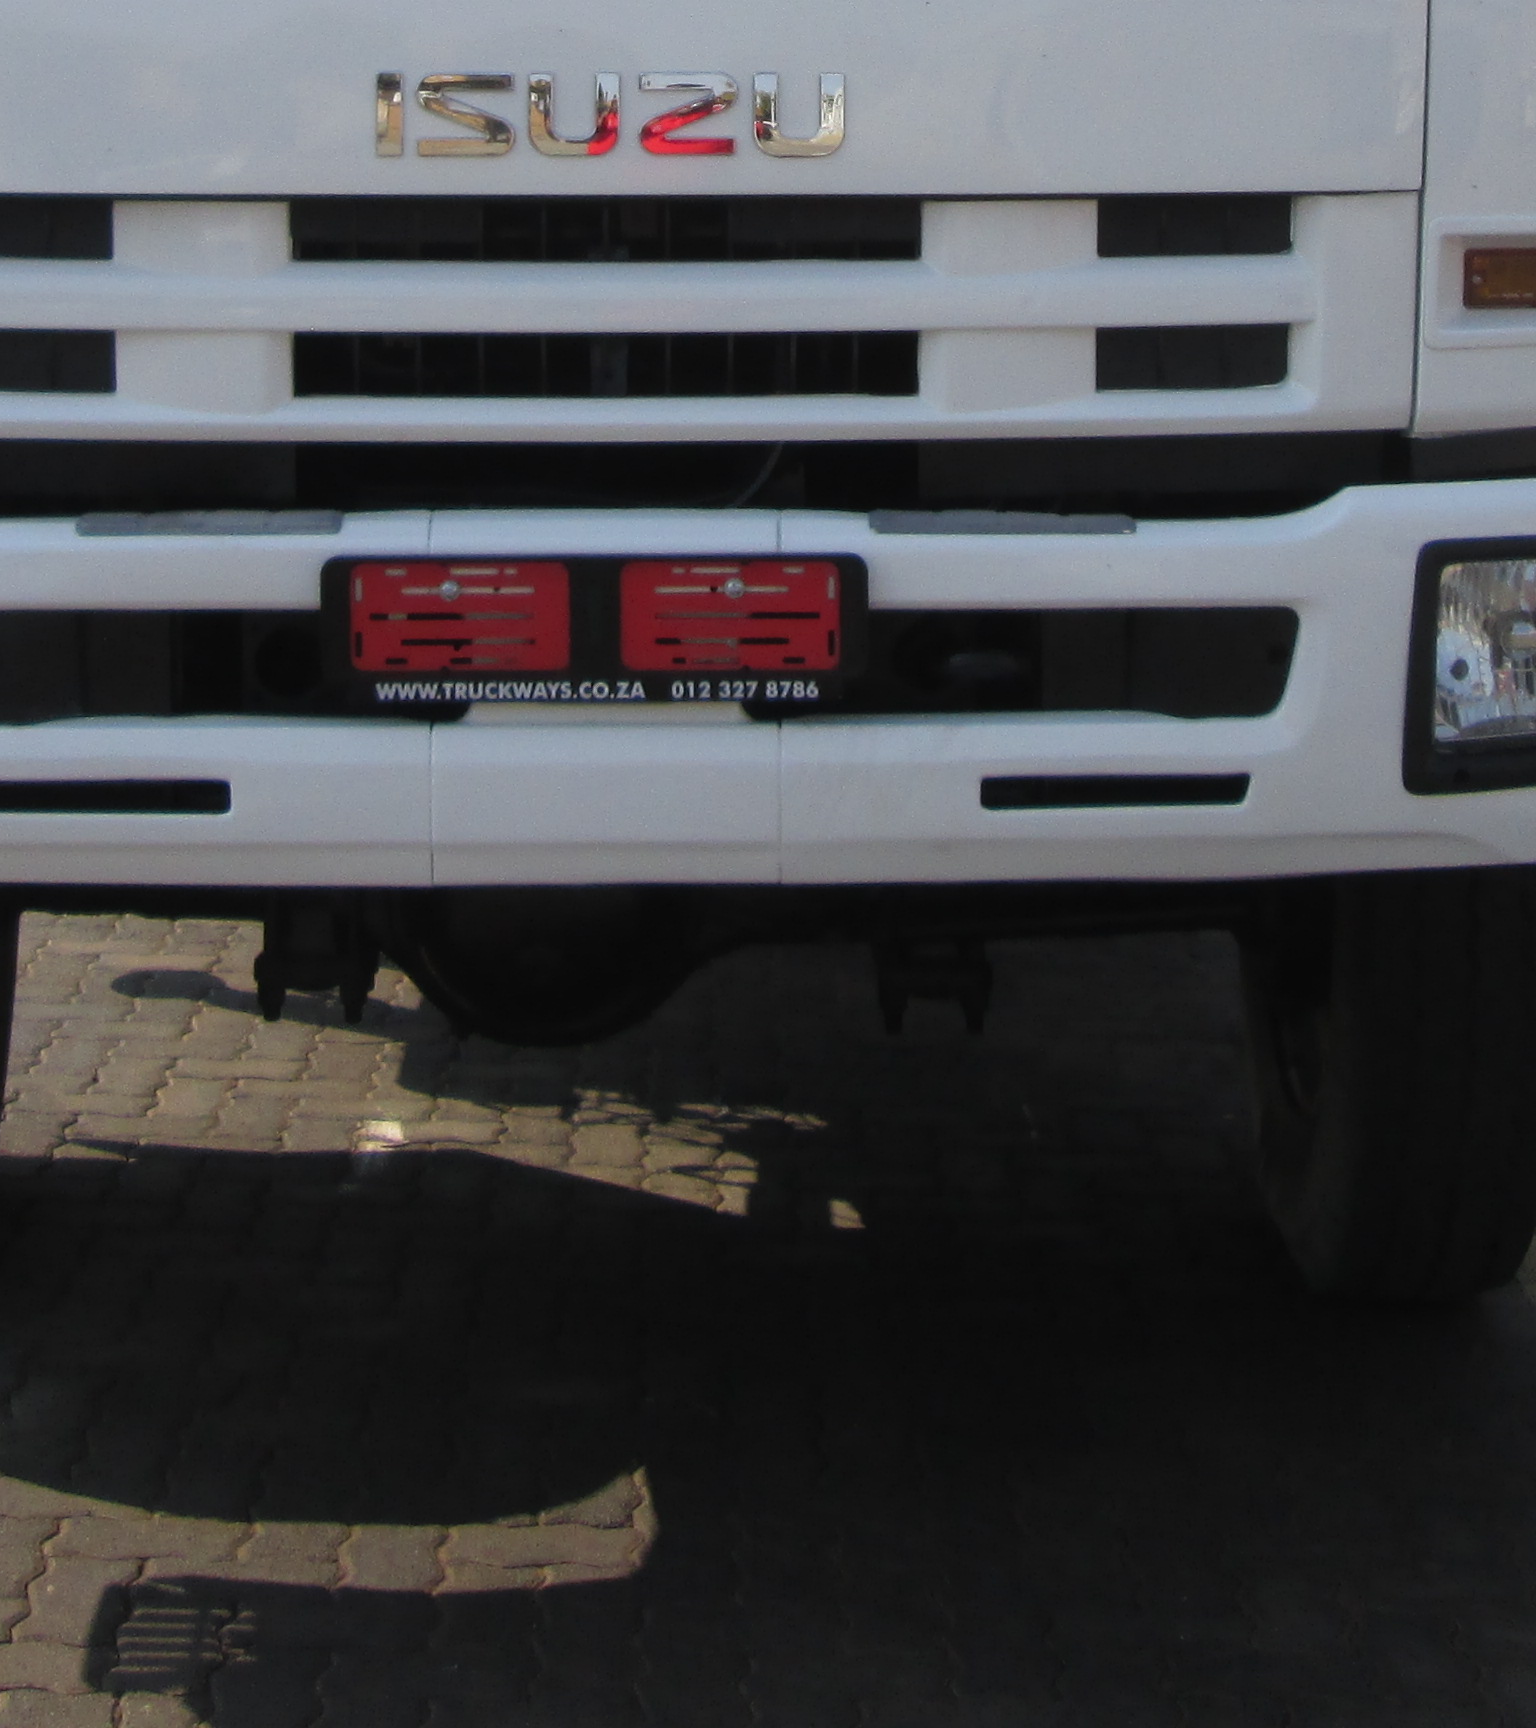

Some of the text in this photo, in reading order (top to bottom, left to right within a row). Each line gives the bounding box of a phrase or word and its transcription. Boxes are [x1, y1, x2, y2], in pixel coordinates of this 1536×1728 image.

[375, 72, 846, 158] ISUZU
[375, 680, 820, 700] WWW.TRUCKWAYS.CO.ZA 012 327 8786
